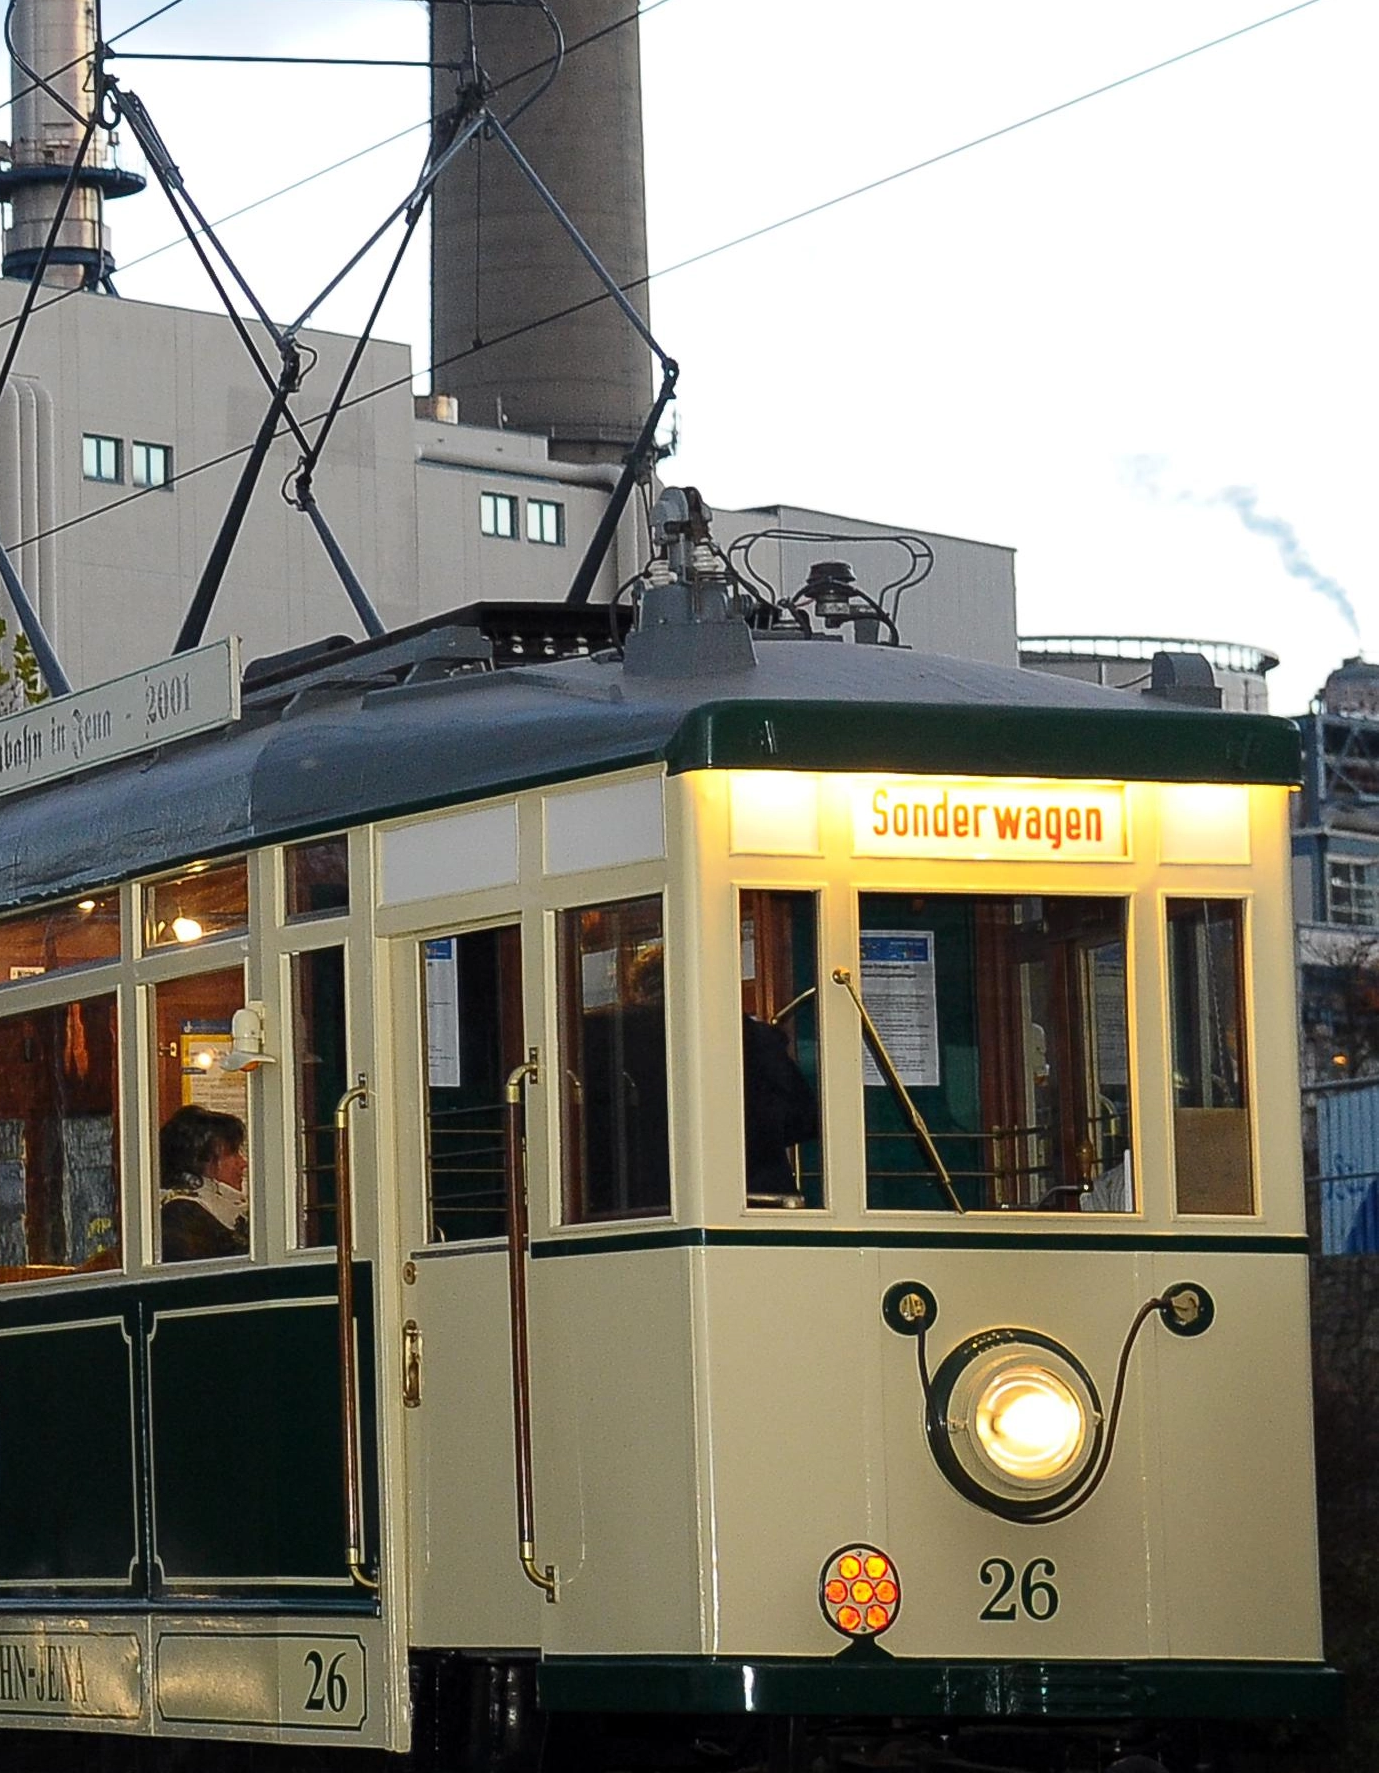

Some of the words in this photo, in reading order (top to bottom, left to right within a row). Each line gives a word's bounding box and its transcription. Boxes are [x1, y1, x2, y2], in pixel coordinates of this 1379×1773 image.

[50, 716, 66, 755] in
[72, 707, 111, 760] Jena
[146, 672, 192, 724] 2001
[872, 788, 1103, 850] Sonderwagen
[978, 1556, 1060, 1622] 26
[303, 1649, 348, 1714] 26
